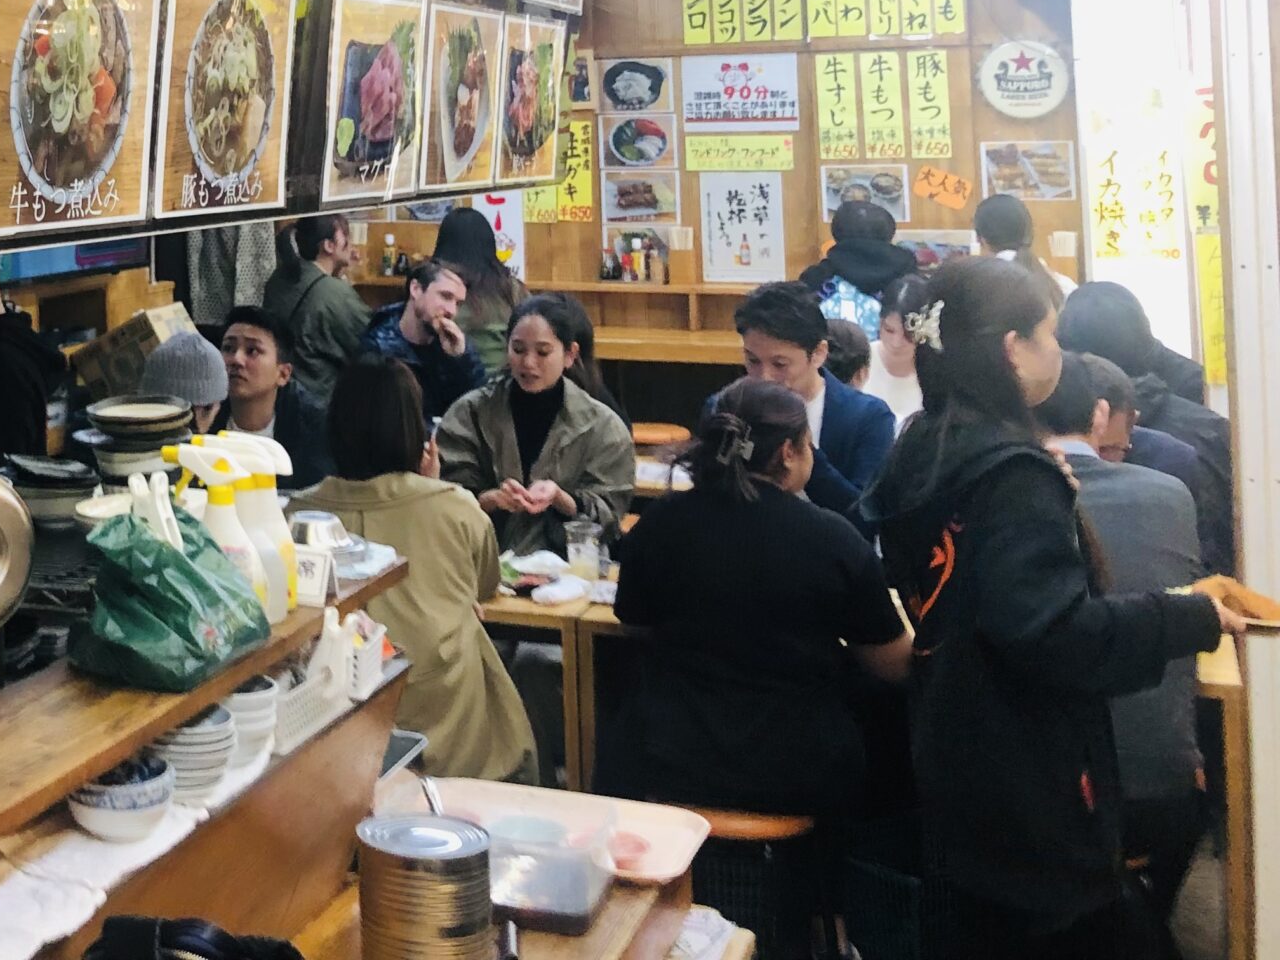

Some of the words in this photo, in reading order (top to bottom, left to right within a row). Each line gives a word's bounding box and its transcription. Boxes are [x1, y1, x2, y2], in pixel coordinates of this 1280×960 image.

[824, 56, 847, 127] 牛すじ
[869, 55, 895, 122] 牛もつ
[915, 53, 945, 120] 豚もつ
[9, 181, 121, 225] 牛もつ煮込み
[180, 170, 264, 208] 豚もつ煮込み
[560, 206, 592, 221] ¥650
